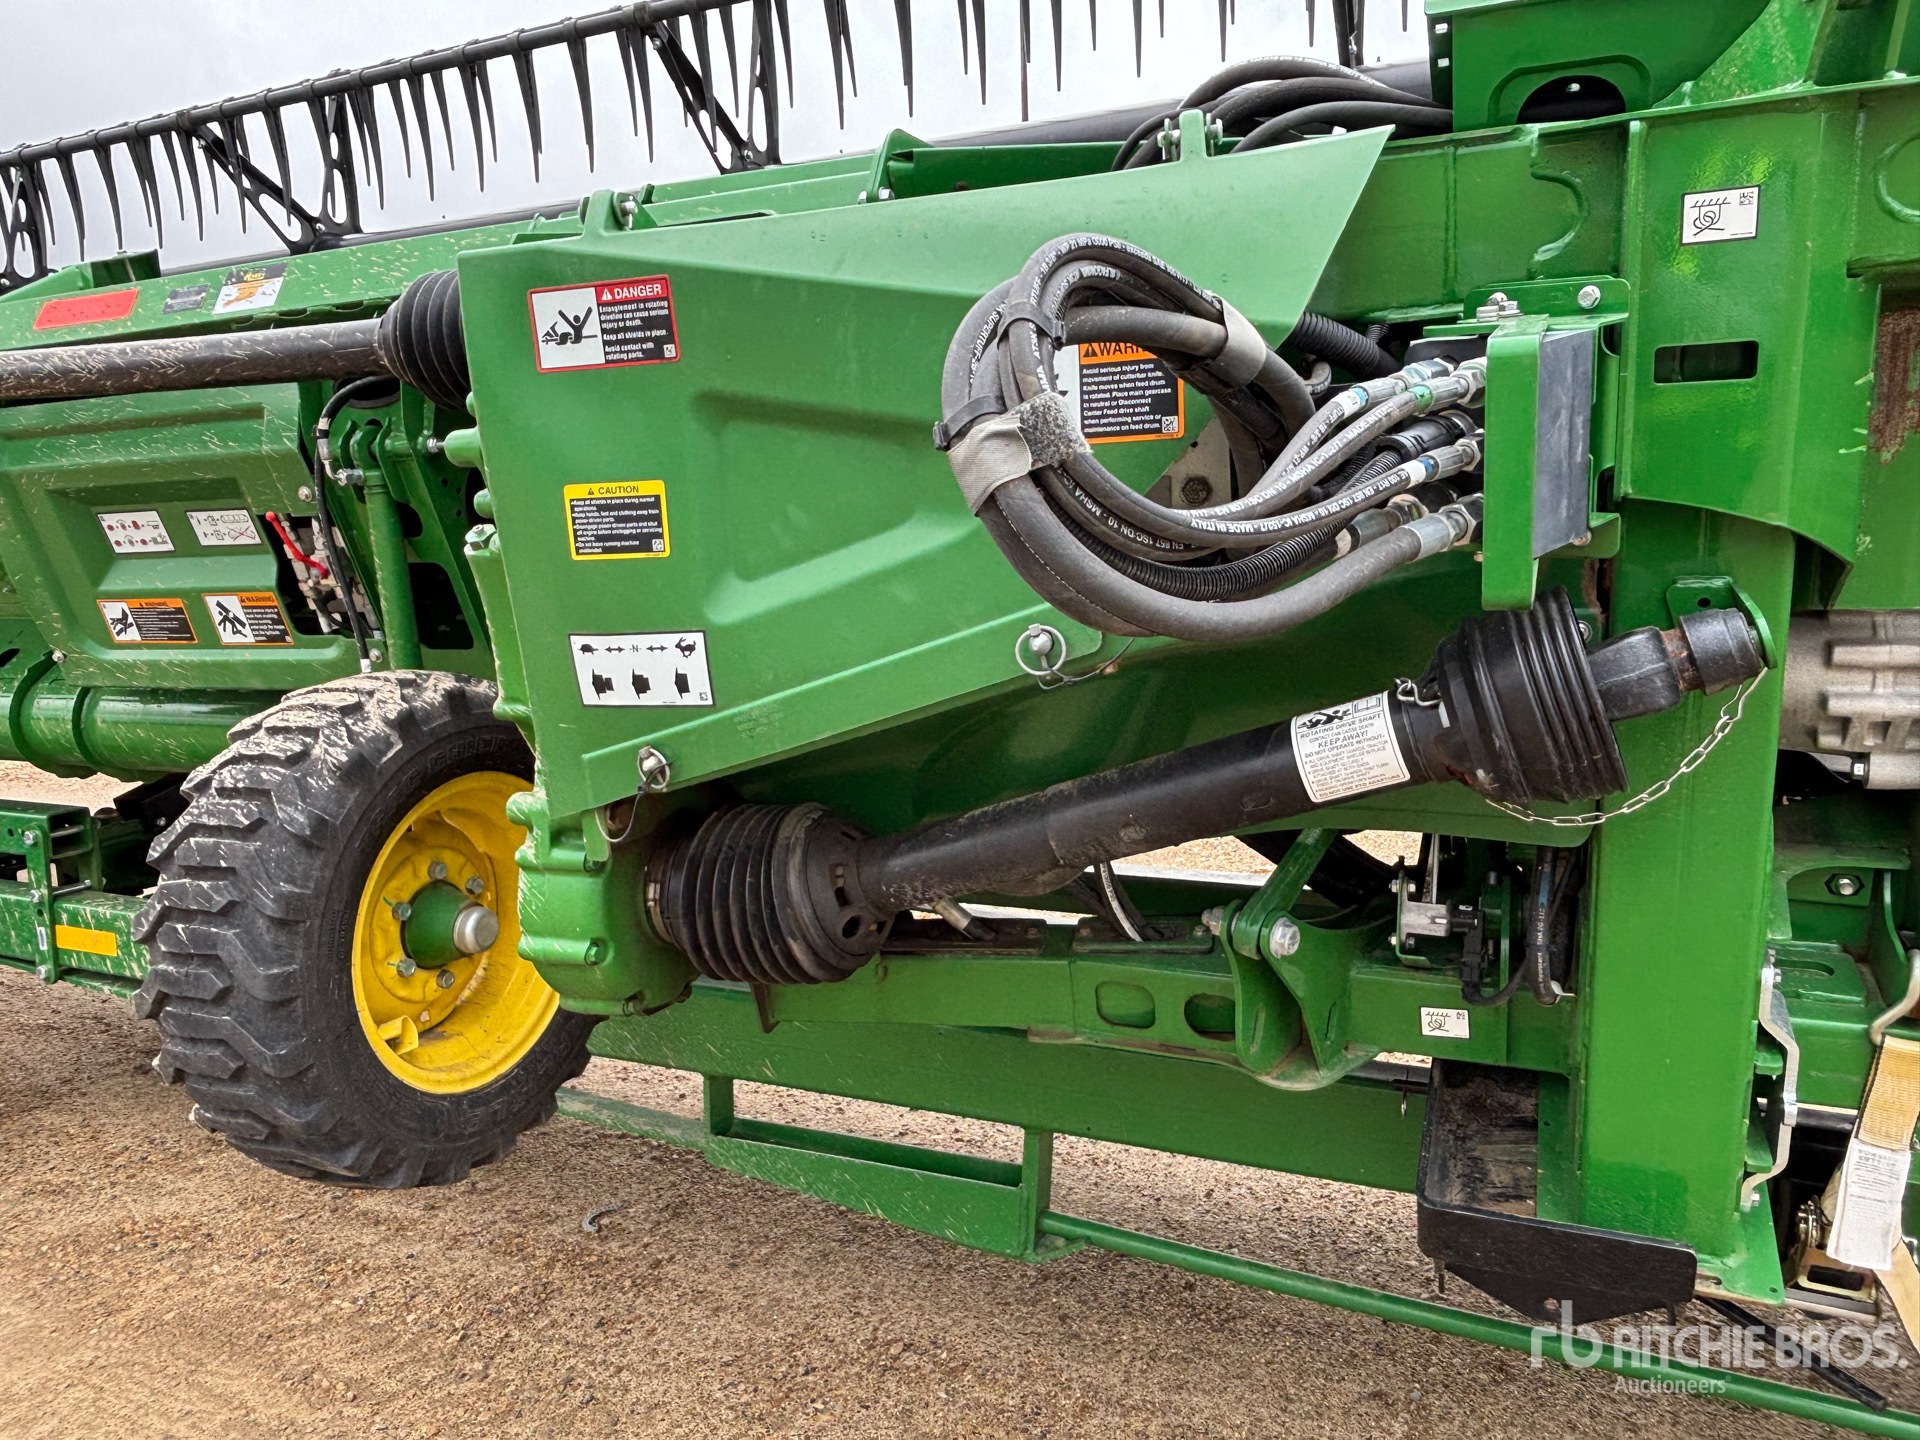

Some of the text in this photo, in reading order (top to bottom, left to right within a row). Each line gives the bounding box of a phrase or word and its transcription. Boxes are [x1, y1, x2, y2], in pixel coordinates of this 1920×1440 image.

[614, 284, 662, 300] DANGER
[651, 328, 669, 338] place.
[973, 309, 1000, 359] SUPERTUFF
[1100, 366, 1121, 374] serious
[1122, 364, 1139, 372] injury
[1082, 375, 1113, 383] movement
[1119, 381, 1135, 389] when
[1149, 379, 1166, 387] drum
[1111, 390, 1128, 398] Place
[1129, 389, 1144, 397] main
[1090, 400, 1110, 408] neutral
[1118, 397, 1151, 406] Disconnect
[1083, 409, 1103, 417] Center
[1118, 406, 1134, 414] drive
[1134, 405, 1150, 413] shaft
[1100, 415, 1132, 425] performing
[1083, 425, 1120, 433] maintenance
[1345, 421, 1369, 440] MADE
[598, 485, 639, 495] CAUTION
[1378, 478, 1391, 491] R17
[1074, 487, 1102, 518] MSHA
[1339, 498, 1353, 509] 1SC
[1318, 507, 1328, 517] 10
[1107, 516, 1118, 529] 10
[1291, 511, 1316, 526] MSHA
[1191, 518, 1216, 532] ITALY
[1216, 522, 1227, 533] IN
[1229, 522, 1254, 533] MADE
[1120, 525, 1135, 538] DN
[1136, 532, 1153, 545] 1SC
[1155, 538, 1170, 549] 857
[1300, 712, 1382, 740] ROTATING DRIVE SHAFT
[1358, 722, 1375, 731] DEATH
[1318, 737, 1340, 749] KEEP
[1327, 741, 1355, 753] OPERATE
